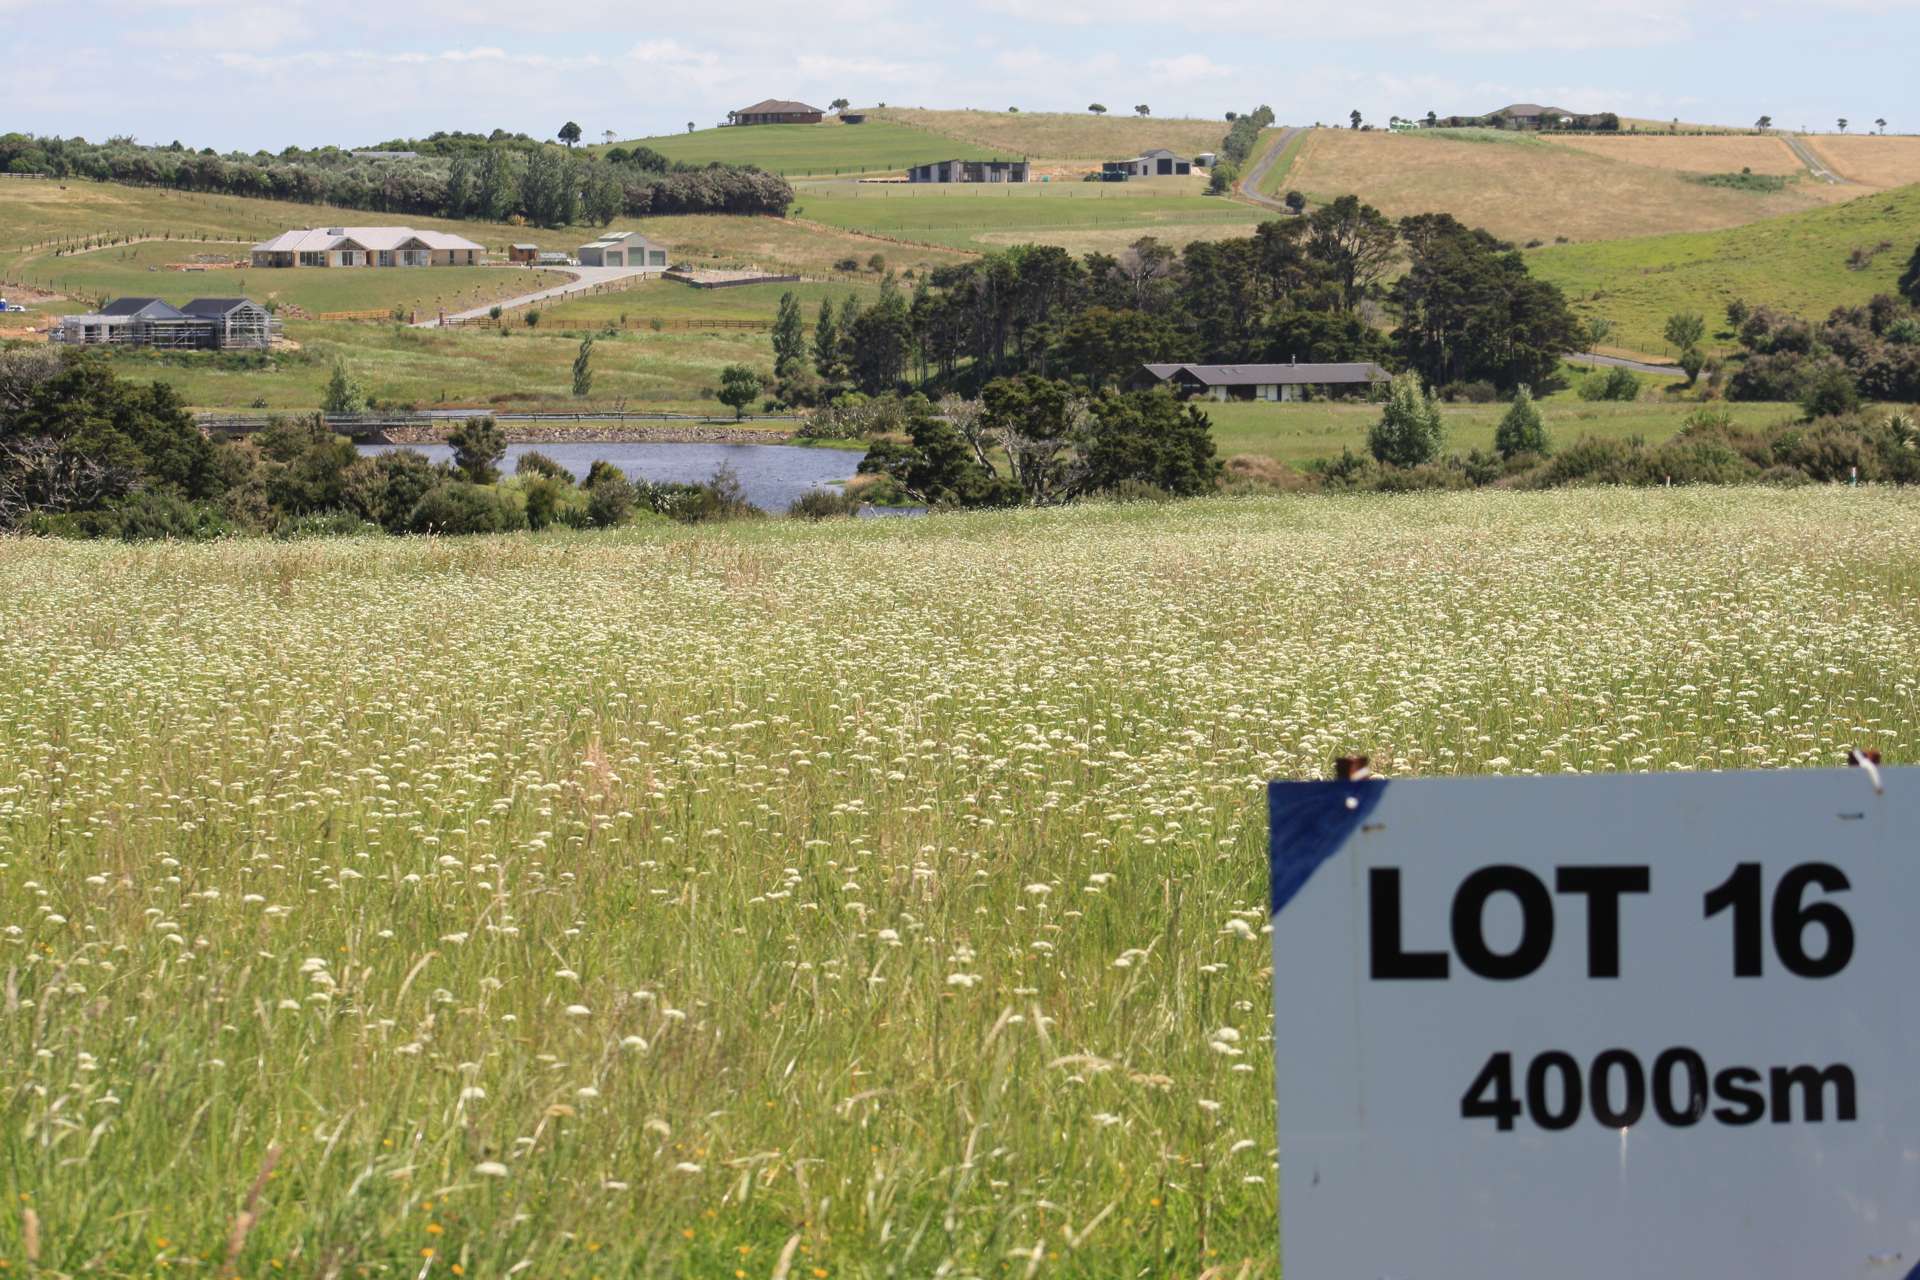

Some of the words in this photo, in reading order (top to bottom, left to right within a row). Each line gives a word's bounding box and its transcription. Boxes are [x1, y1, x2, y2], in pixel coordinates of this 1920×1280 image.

[1367, 863, 1651, 982] LOT
[1703, 861, 1856, 980] 16
[1460, 1046, 1858, 1132] 4000sm
